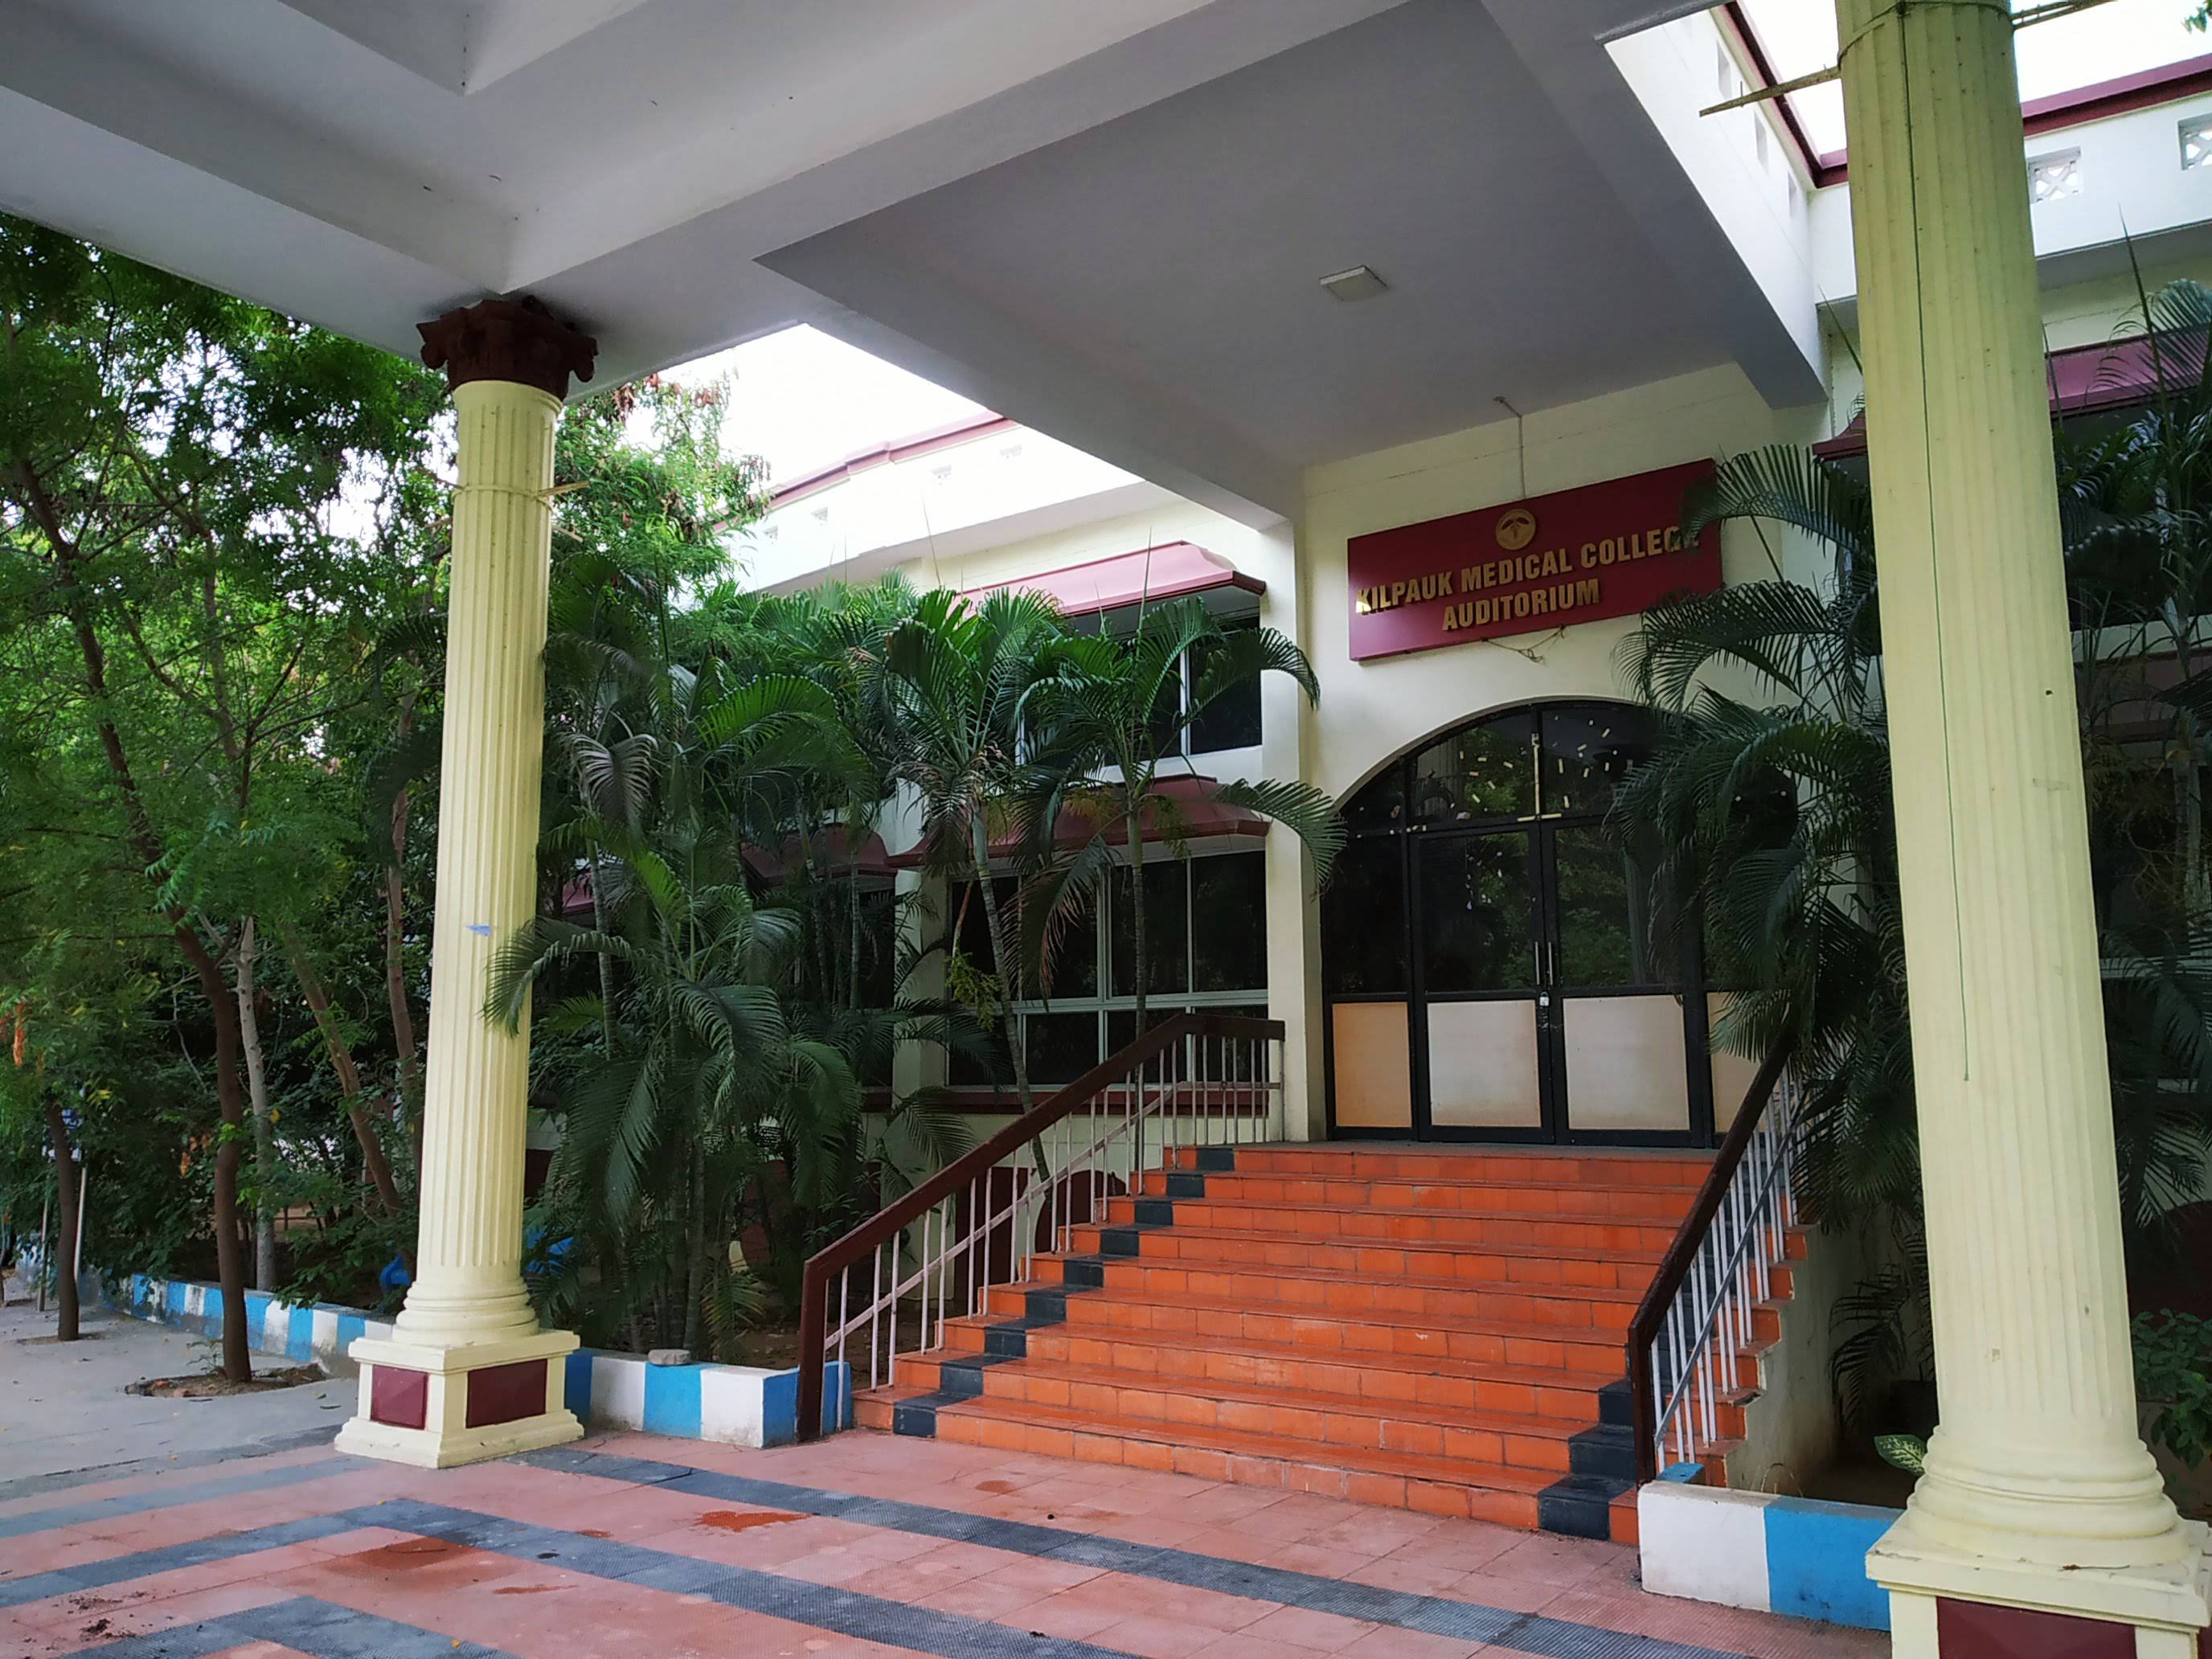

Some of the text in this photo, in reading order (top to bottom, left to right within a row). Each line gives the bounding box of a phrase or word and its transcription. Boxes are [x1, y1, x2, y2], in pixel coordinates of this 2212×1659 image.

[1356, 526, 1699, 614] KILPAUK MEDICAL COLLEG
[1443, 579, 1600, 631] AUDITORIUM
